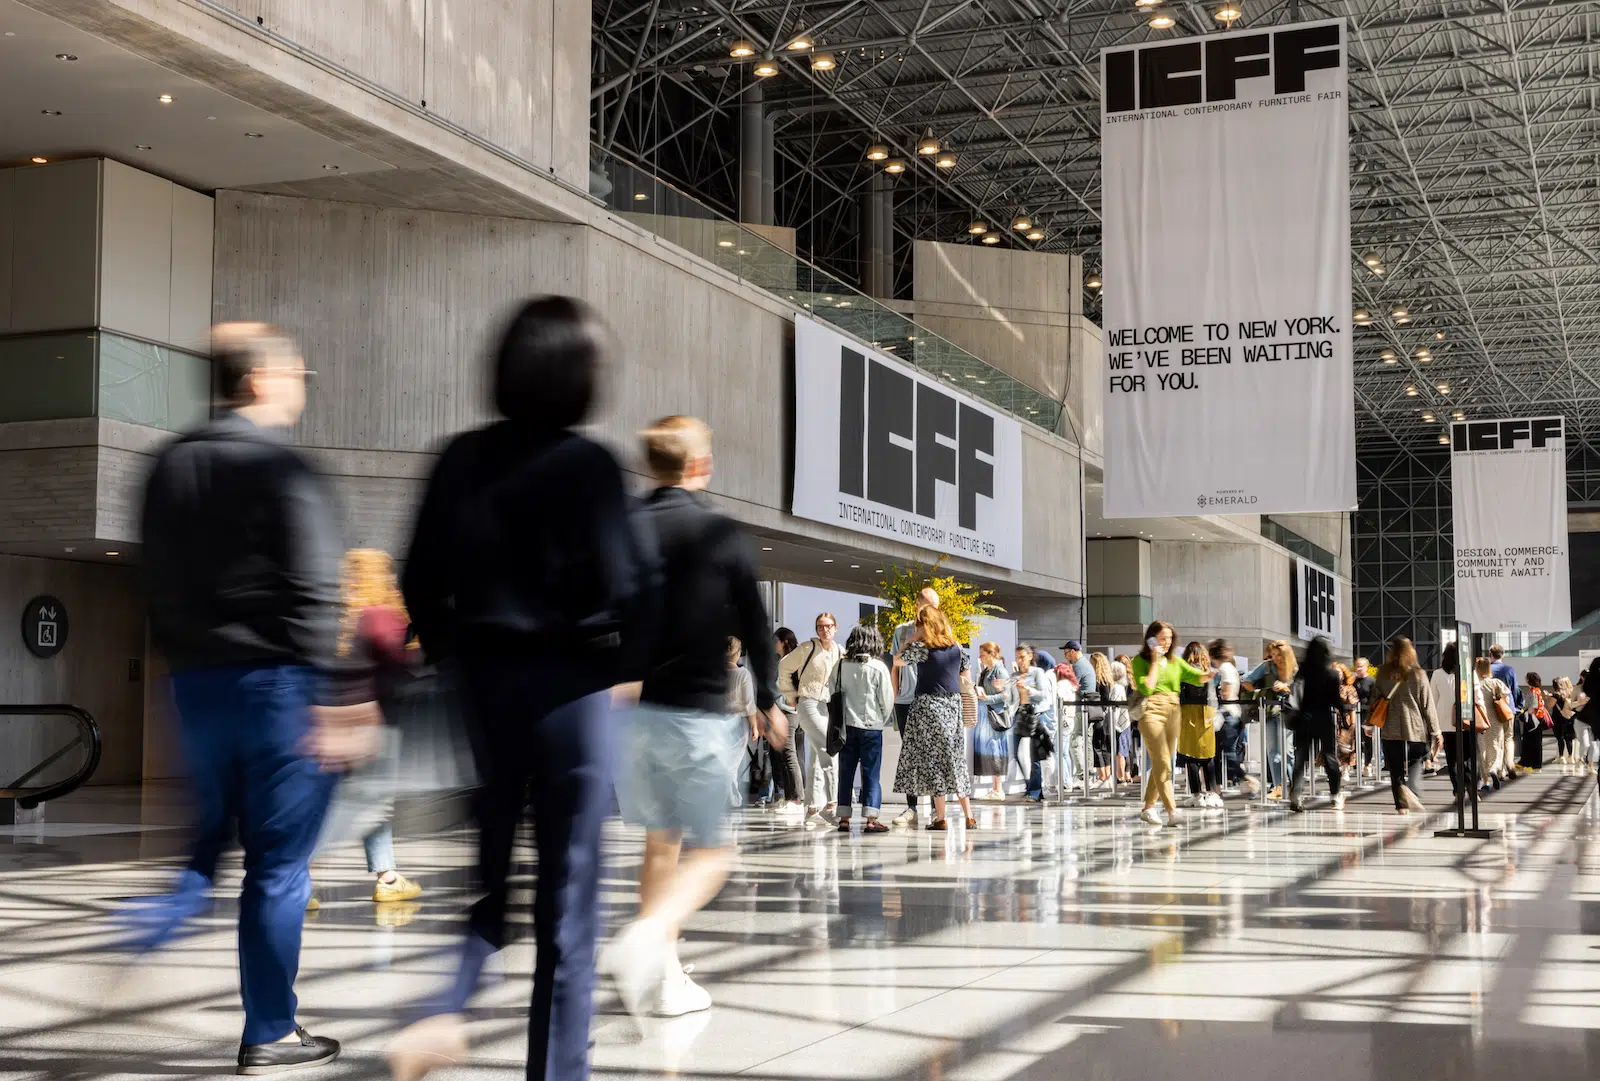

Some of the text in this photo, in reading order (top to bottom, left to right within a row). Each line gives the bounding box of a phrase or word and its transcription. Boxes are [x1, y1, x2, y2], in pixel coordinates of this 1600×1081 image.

[1105, 24, 1340, 113] ICFF
[1106, 91, 1342, 124] INTERNATIONAL CONTEMPORARY FURNITURE FAIR
[1108, 316, 1341, 347] WELCOME TO NEW YORK.
[1109, 340, 1334, 370] WE'VE BEEN WAITING
[1110, 372, 1199, 393] FOR YOU.
[839, 345, 995, 531] ICFF
[1453, 418, 1562, 451] ICFF
[1208, 495, 1258, 506] EMERALD
[838, 501, 996, 558] INTERNATIONAL CONTEMPORARY FURNITURE FAIR
[1456, 546, 1564, 558] DESIGN, COMMERCE,
[1457, 557, 1545, 568] COMMUNITY AND
[1457, 567, 1550, 578] CULTURE AWAIT.
[1304, 564, 1335, 633] ICFF
